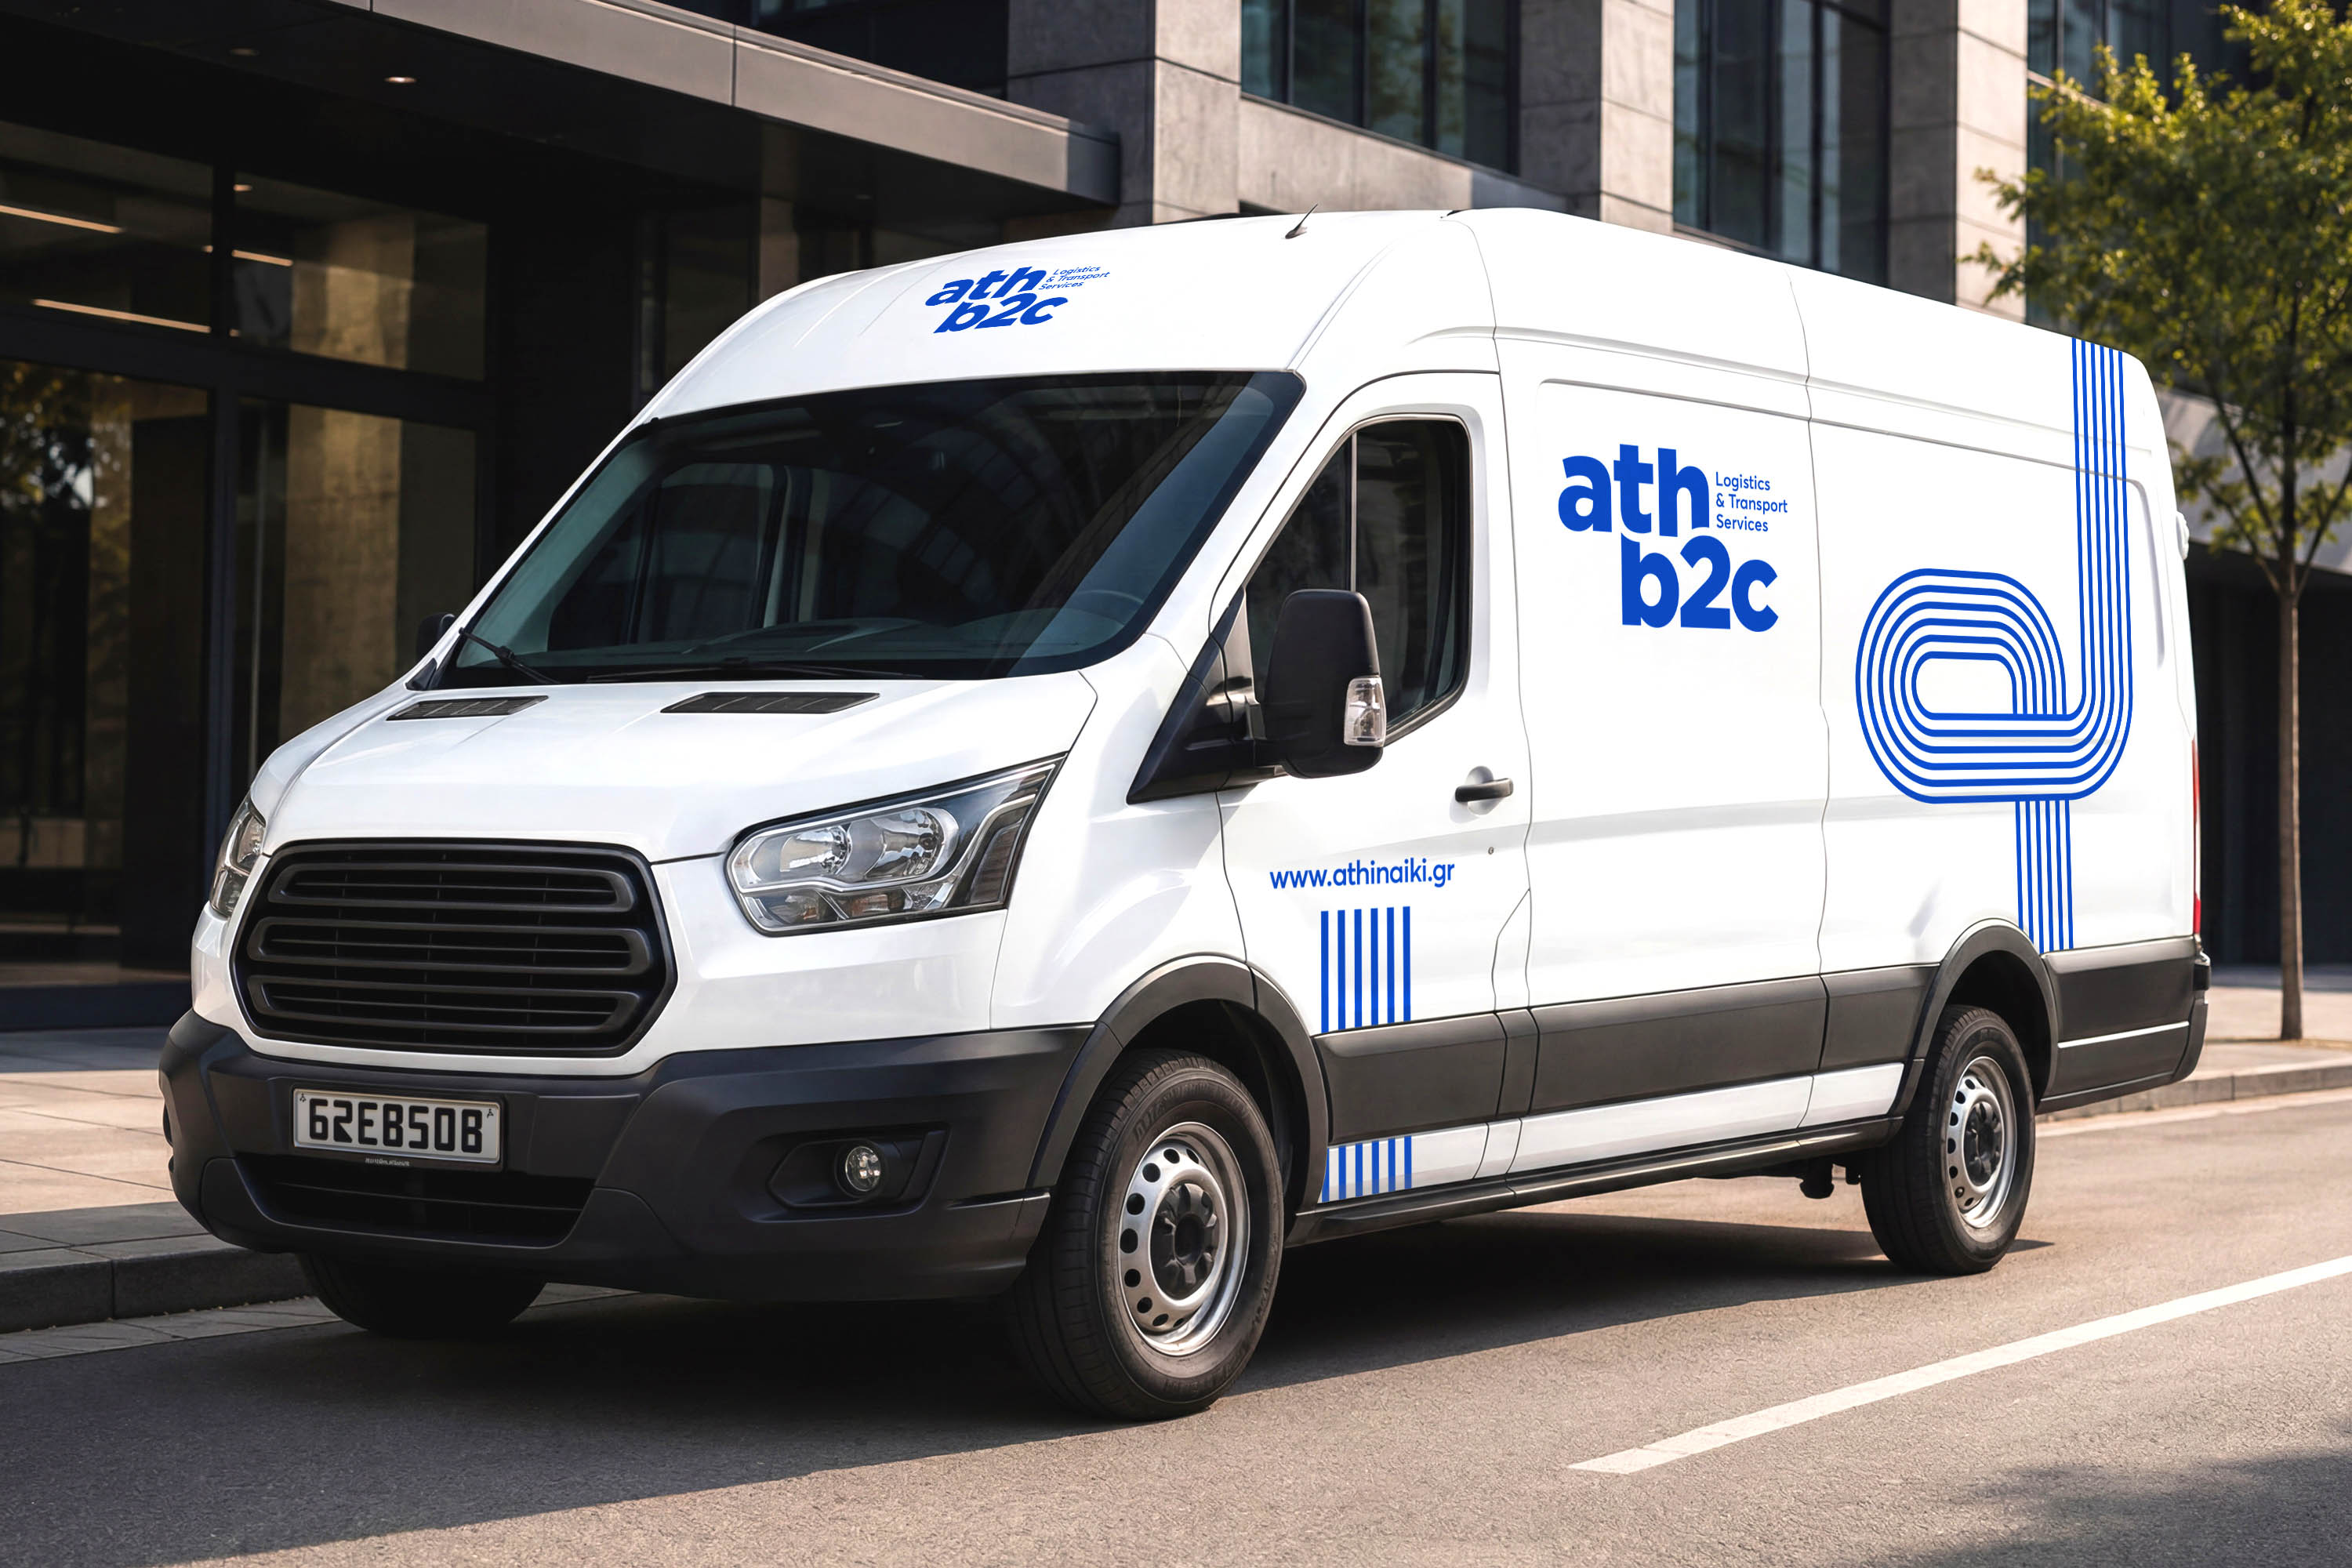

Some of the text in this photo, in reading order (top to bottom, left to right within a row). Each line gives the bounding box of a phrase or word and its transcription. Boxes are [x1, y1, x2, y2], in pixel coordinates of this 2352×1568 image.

[1053, 266, 1101, 275] Logistics
[1058, 271, 1111, 282] Transport
[925, 267, 1047, 306] ath
[1038, 281, 1084, 290] Services
[933, 292, 1069, 333] b2c
[1558, 444, 1710, 537] ath
[1715, 471, 1770, 492] Logistics
[1715, 492, 1788, 515] & Transport
[1716, 514, 1769, 532] Services
[1621, 532, 1779, 632] b2c
[1269, 857, 1455, 889] www.athinaiki.gr
